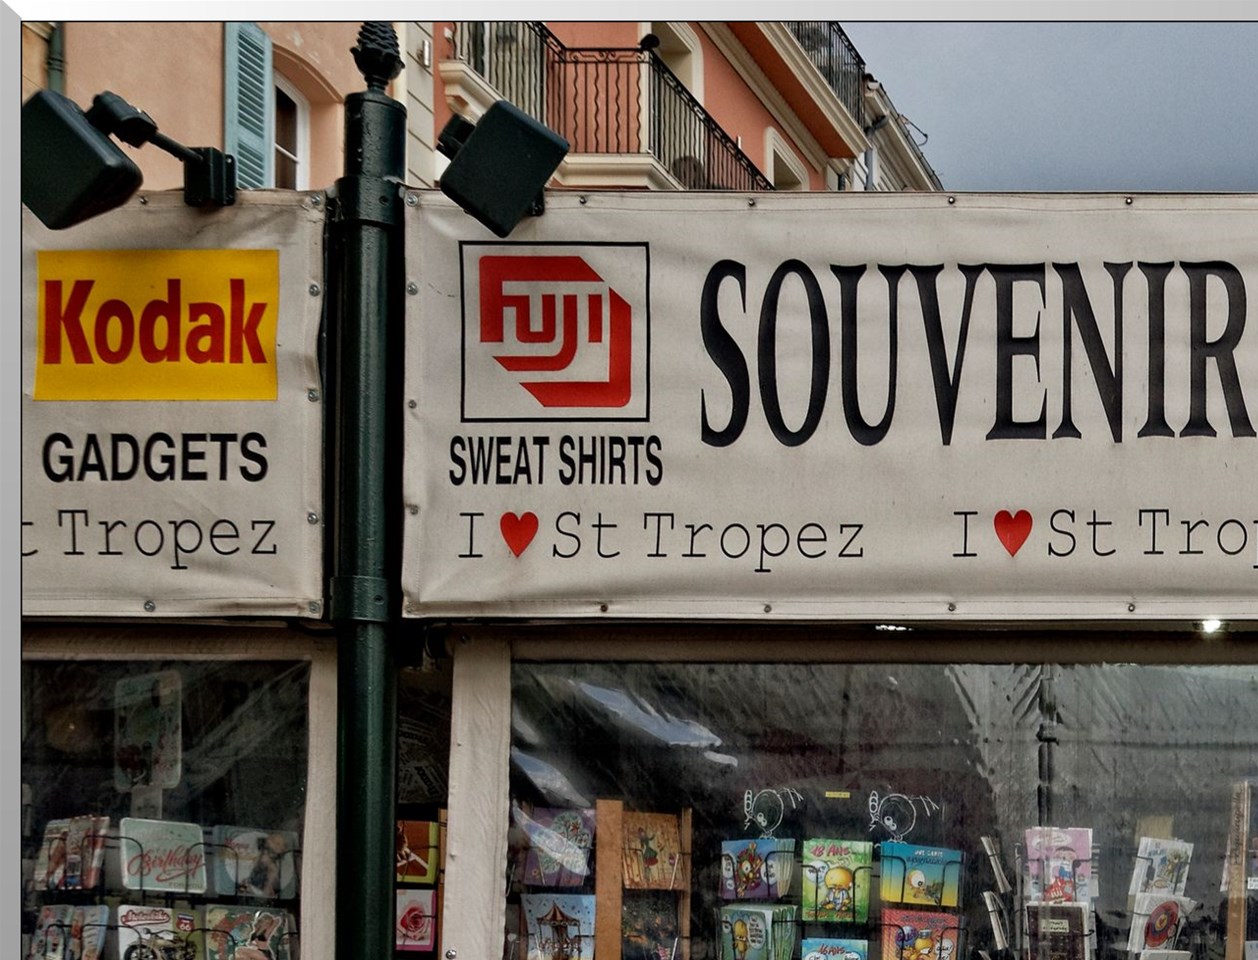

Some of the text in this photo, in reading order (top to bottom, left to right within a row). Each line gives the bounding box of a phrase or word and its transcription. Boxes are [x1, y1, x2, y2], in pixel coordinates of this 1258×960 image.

[43, 278, 268, 365] Kodak
[479, 255, 631, 407] FUJI
[42, 432, 269, 482] GADGETS
[449, 435, 663, 486] SWEAT SHIRTS
[58, 509, 277, 570] Tropez
[457, 511, 864, 572] I St Tropez
[952, 510, 979, 557] I
[1047, 508, 1118, 557] St
